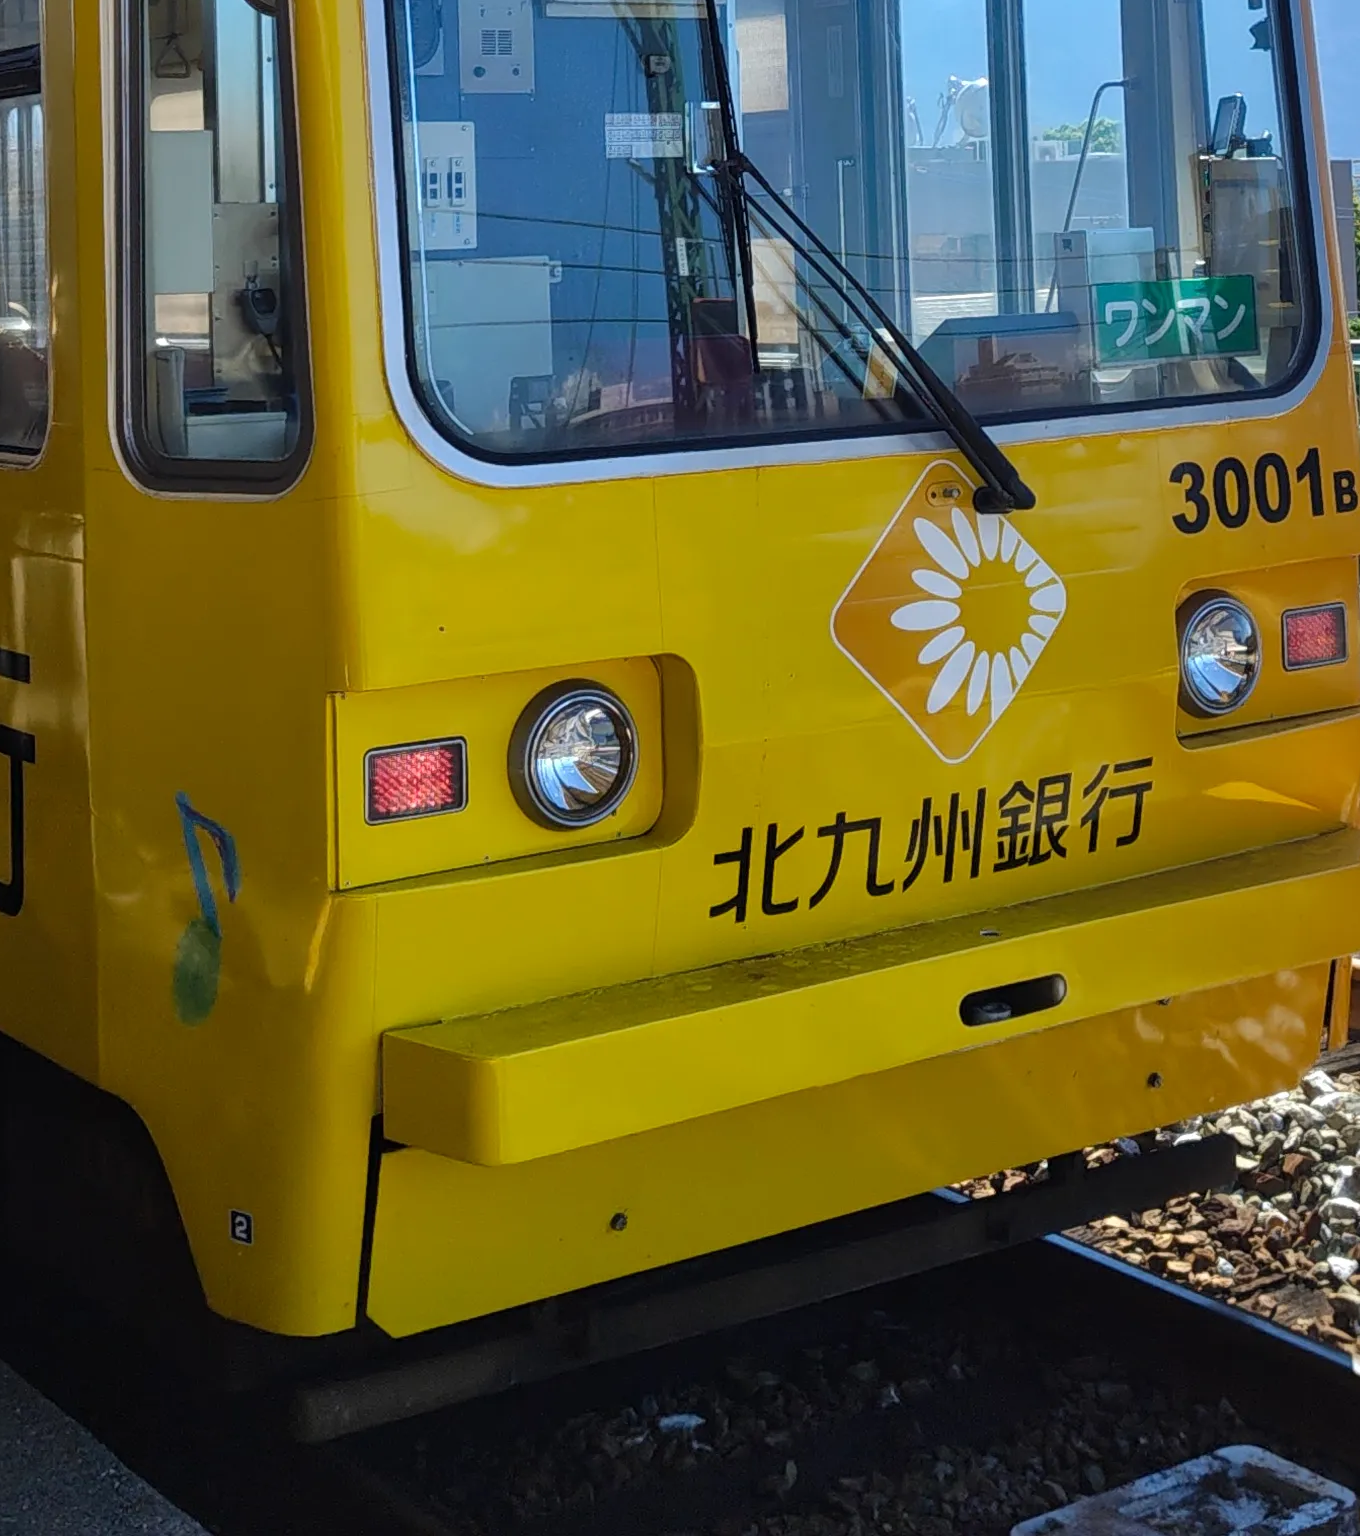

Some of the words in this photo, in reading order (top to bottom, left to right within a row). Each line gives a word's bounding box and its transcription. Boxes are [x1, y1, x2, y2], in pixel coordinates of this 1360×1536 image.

[1103, 297, 1247, 350] ワンマン
[708, 756, 1154, 923] 北九州銀行
